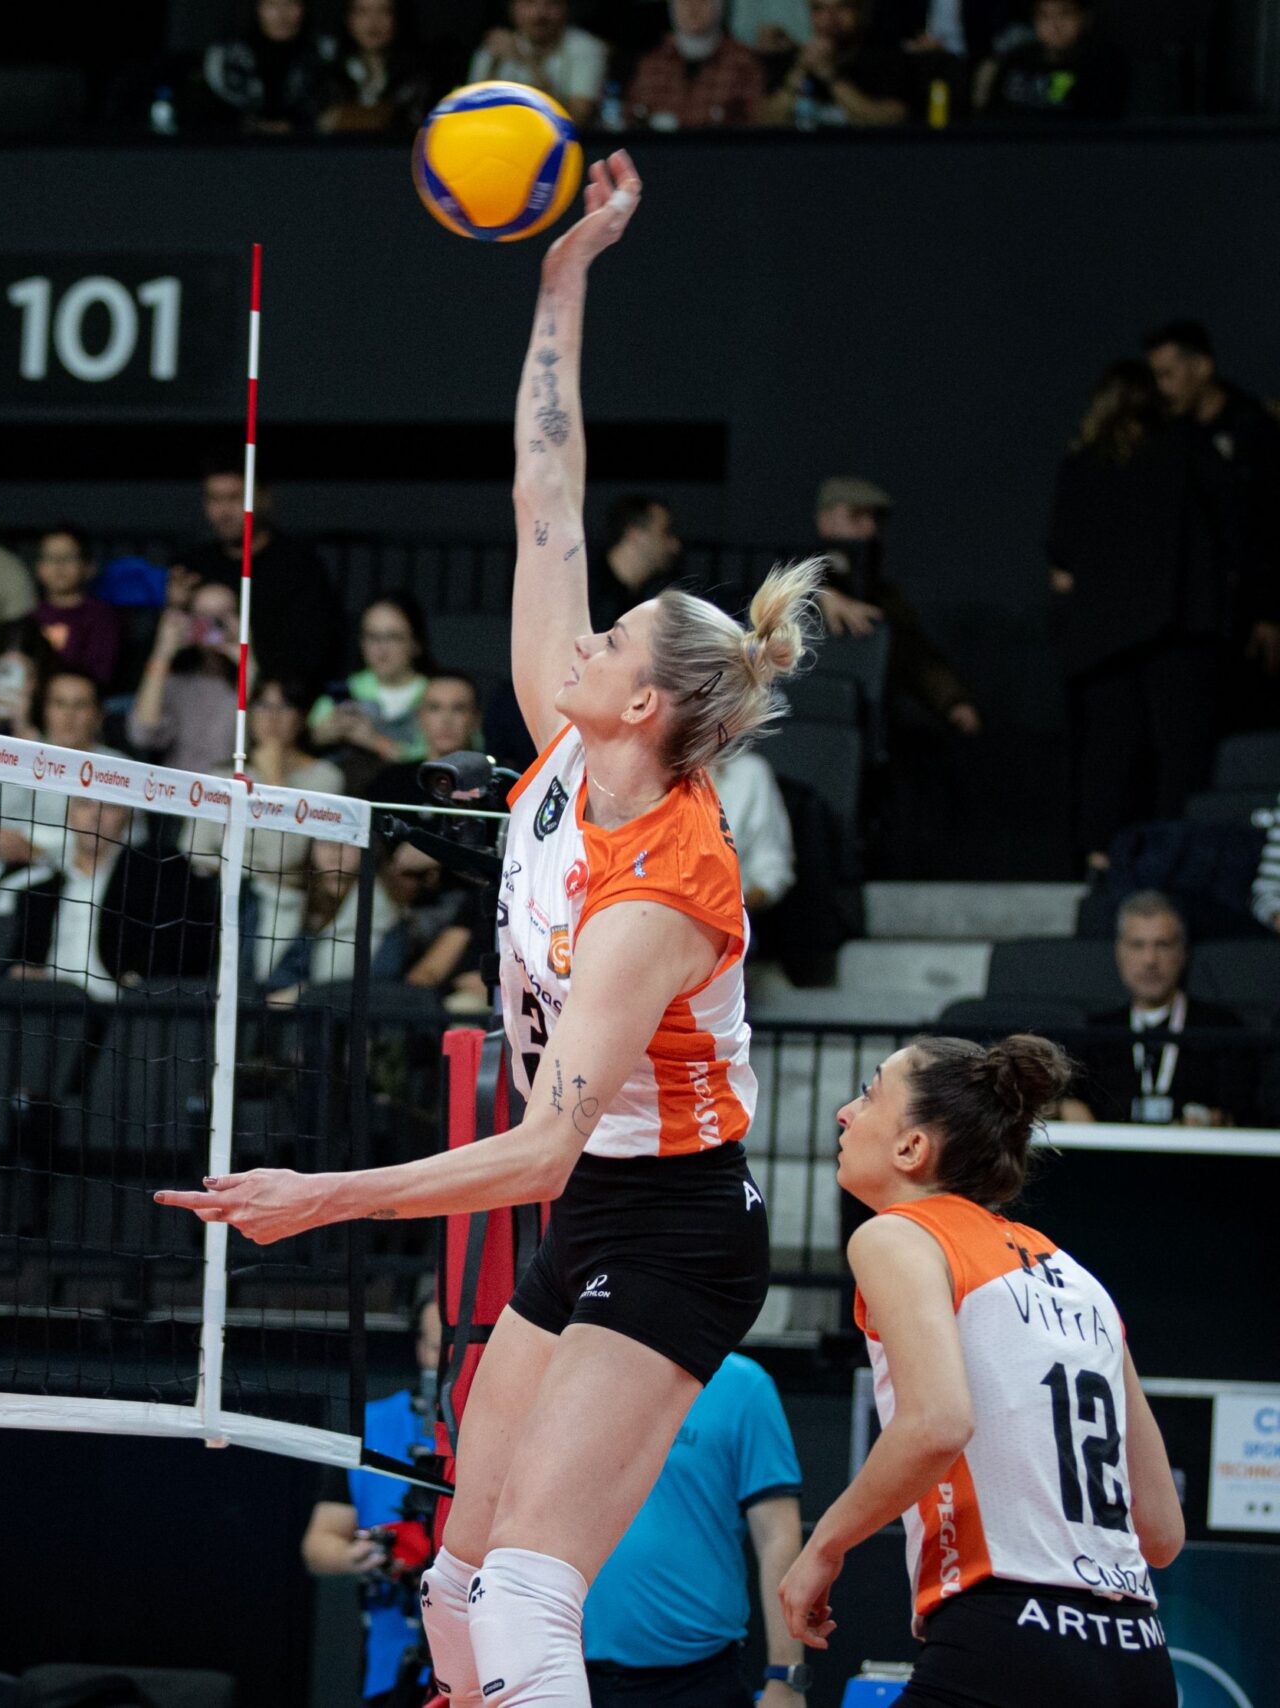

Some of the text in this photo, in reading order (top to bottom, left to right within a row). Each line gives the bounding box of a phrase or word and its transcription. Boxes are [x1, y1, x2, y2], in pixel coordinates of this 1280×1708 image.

[7, 275, 181, 382] 101
[48, 761, 66, 778] TVF
[94, 769, 130, 788] vodafone
[158, 782, 176, 797] TVF
[267, 801, 284, 815] TVF
[309, 807, 342, 823] vodafone
[685, 1061, 723, 1151] PEGASU
[1253, 1406, 1280, 1434] C
[1040, 1362, 1130, 1533] 12
